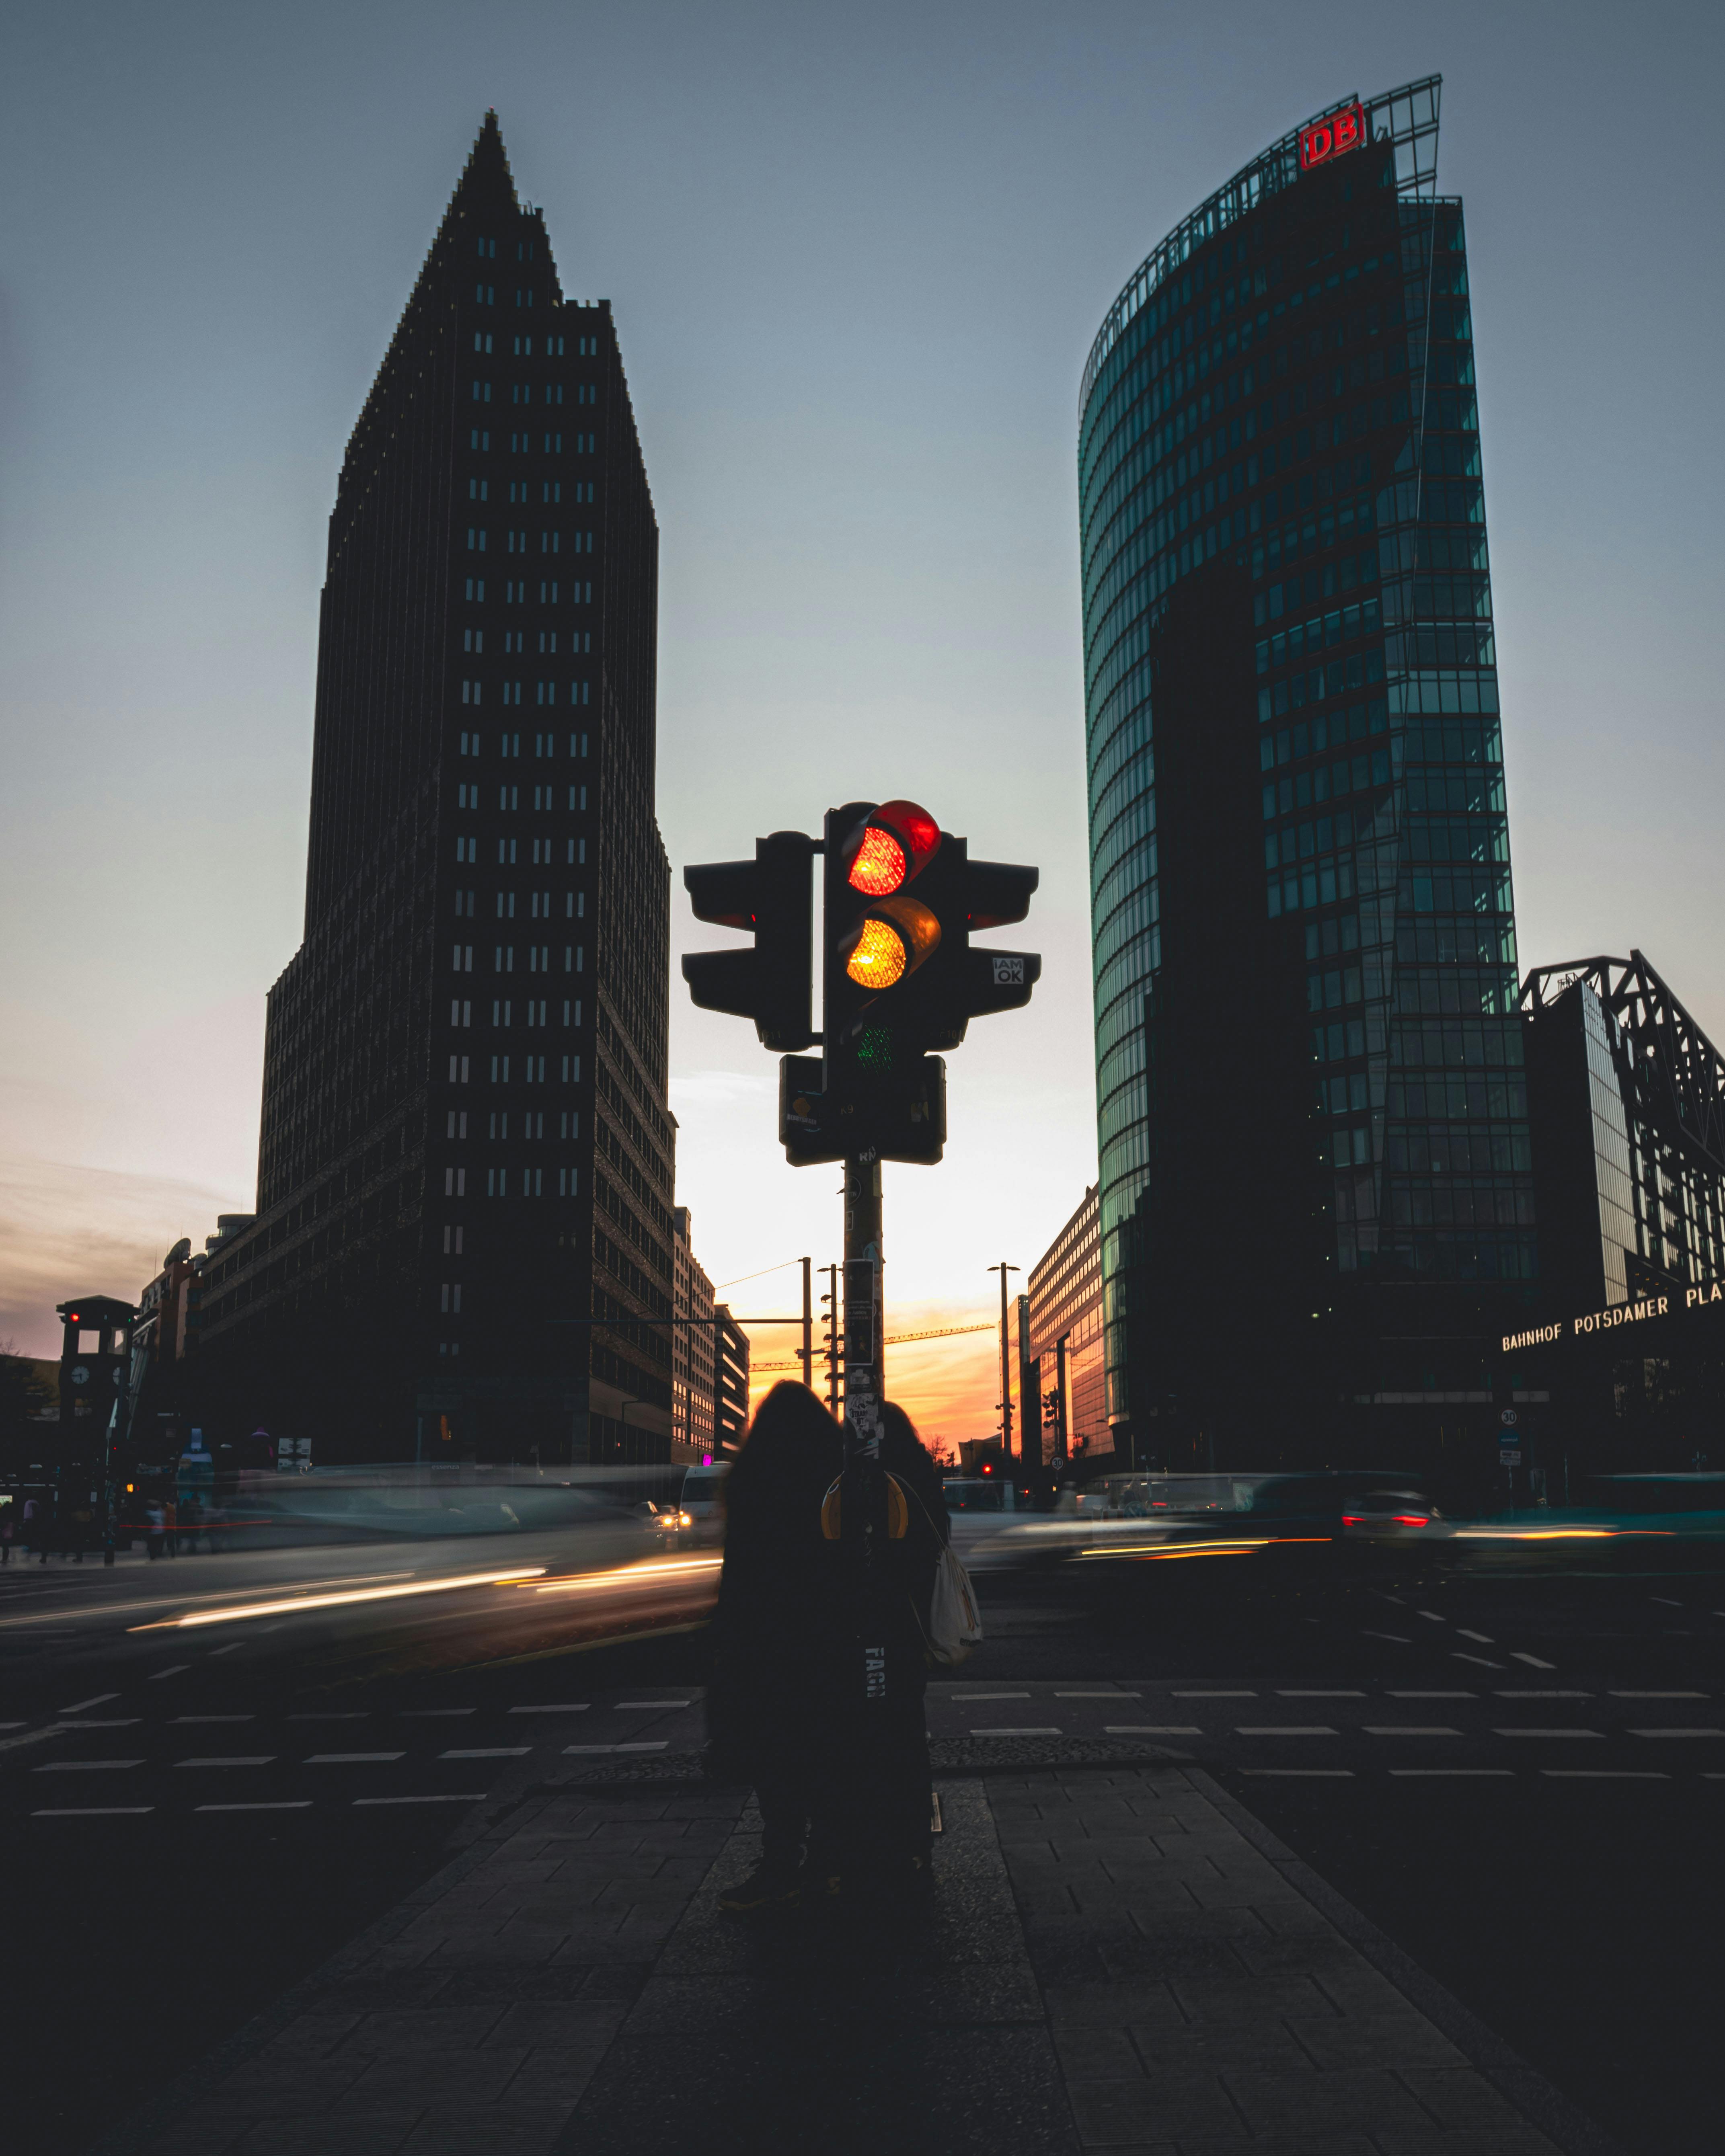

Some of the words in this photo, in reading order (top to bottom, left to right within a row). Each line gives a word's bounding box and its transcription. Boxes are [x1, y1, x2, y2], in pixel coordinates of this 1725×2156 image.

[1308, 114, 1357, 163] DB
[998, 970, 1022, 983] OK
[840, 1104, 854, 1115] K9
[1502, 1323, 1562, 1351] BAHNHOF
[1575, 1296, 1668, 1334] POTSDAMER
[1503, 1412, 1516, 1422] 30
[1053, 1459, 1062, 1467] 30
